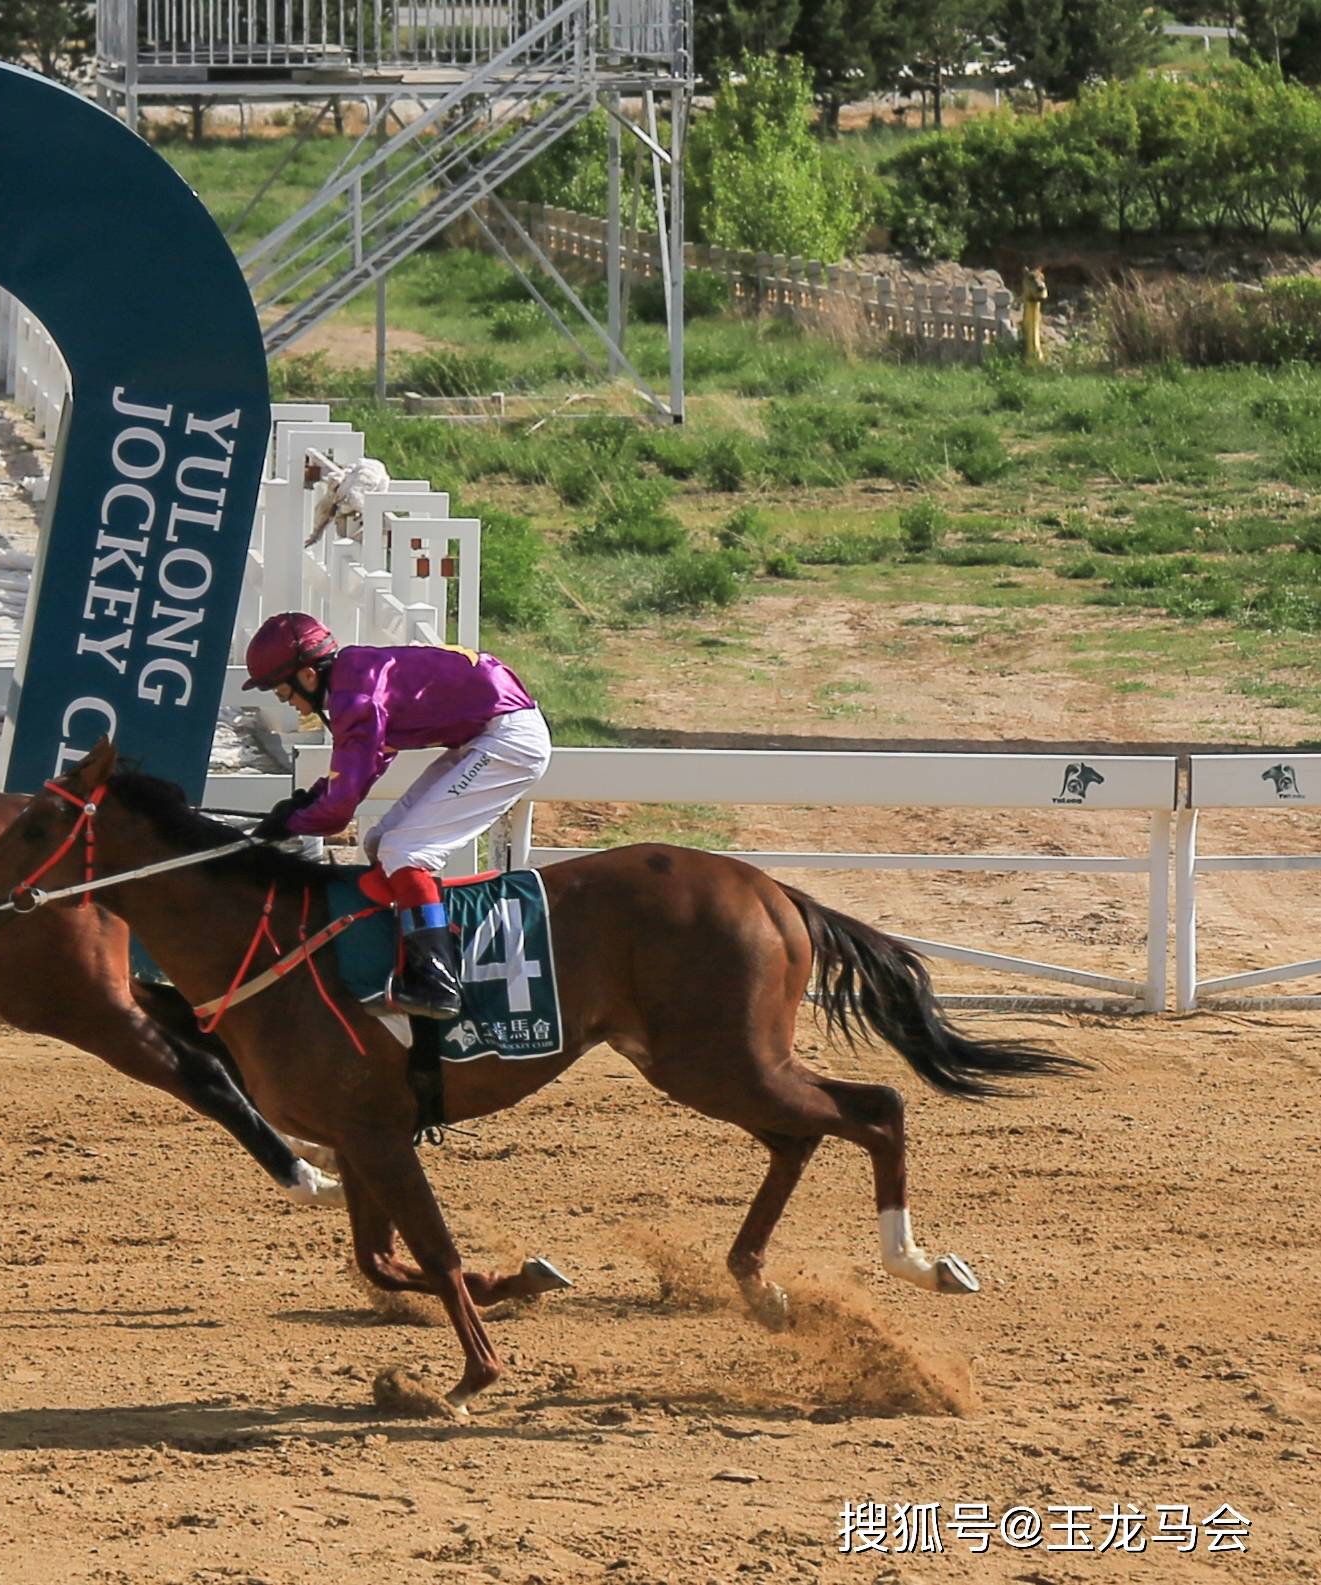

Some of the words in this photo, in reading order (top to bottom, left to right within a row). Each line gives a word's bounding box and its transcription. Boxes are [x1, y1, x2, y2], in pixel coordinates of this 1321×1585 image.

[76, 386, 174, 675] JOCKEY
[137, 408, 241, 707] YULONG
[53, 696, 117, 780] CL
[447, 754, 492, 797] Yulong
[461, 898, 542, 1012] 4
